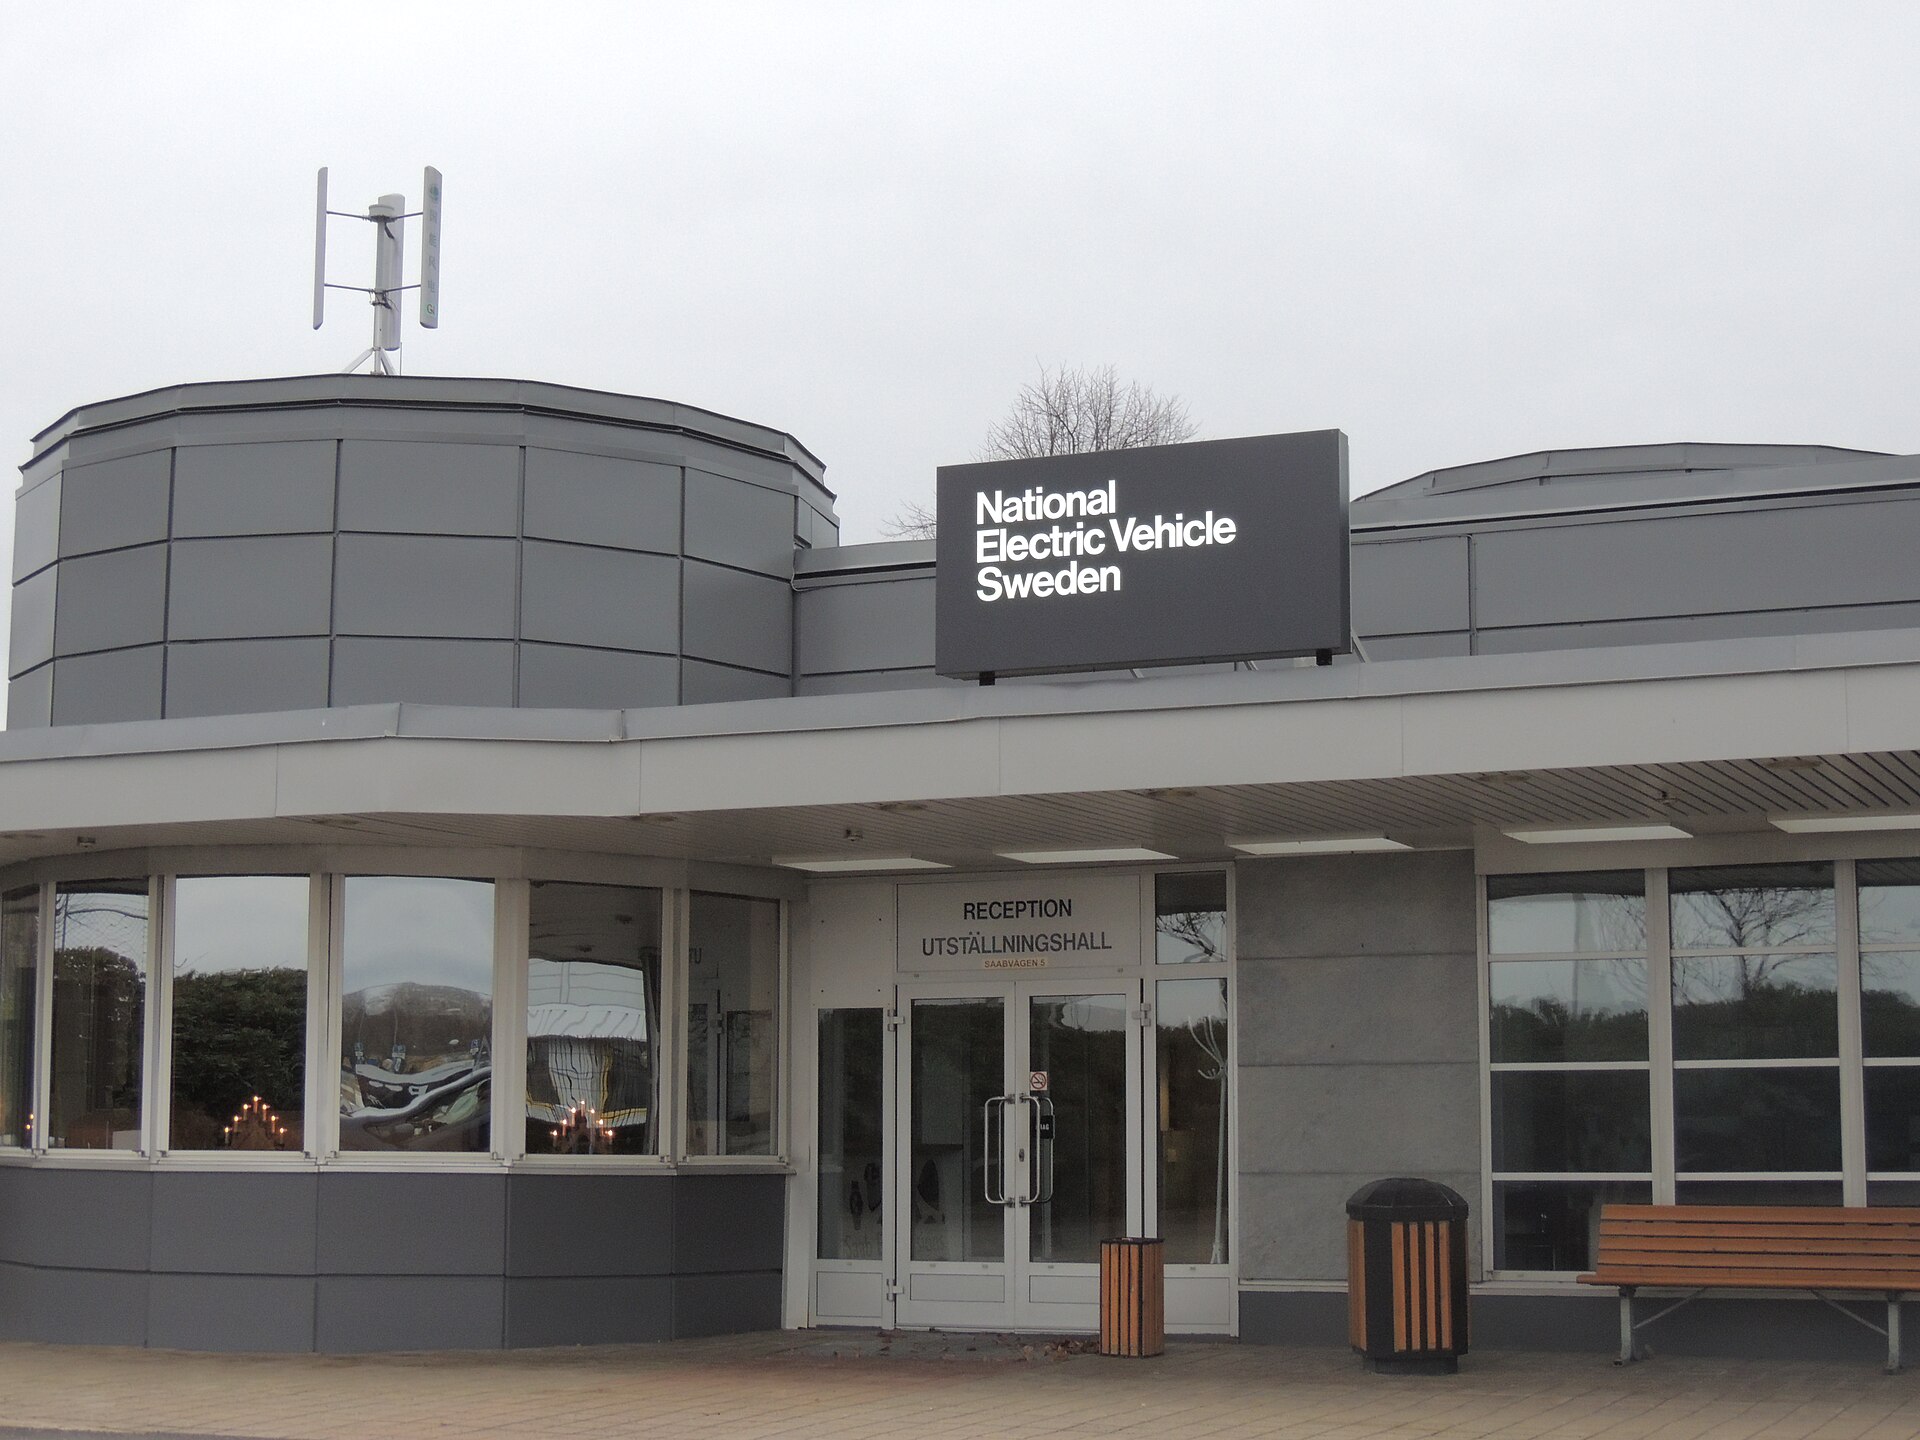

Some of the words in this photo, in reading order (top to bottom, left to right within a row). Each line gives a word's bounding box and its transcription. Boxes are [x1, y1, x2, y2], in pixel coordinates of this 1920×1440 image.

[975, 479, 1117, 525] National
[976, 521, 1106, 564] Electric
[1109, 510, 1237, 553] Vehicle
[976, 560, 1121, 602] Sweden
[963, 899, 1073, 920] RECEPTION
[922, 931, 1112, 956] UTSTÄLLNINGSHALL
[1040, 958, 1046, 967] 5
